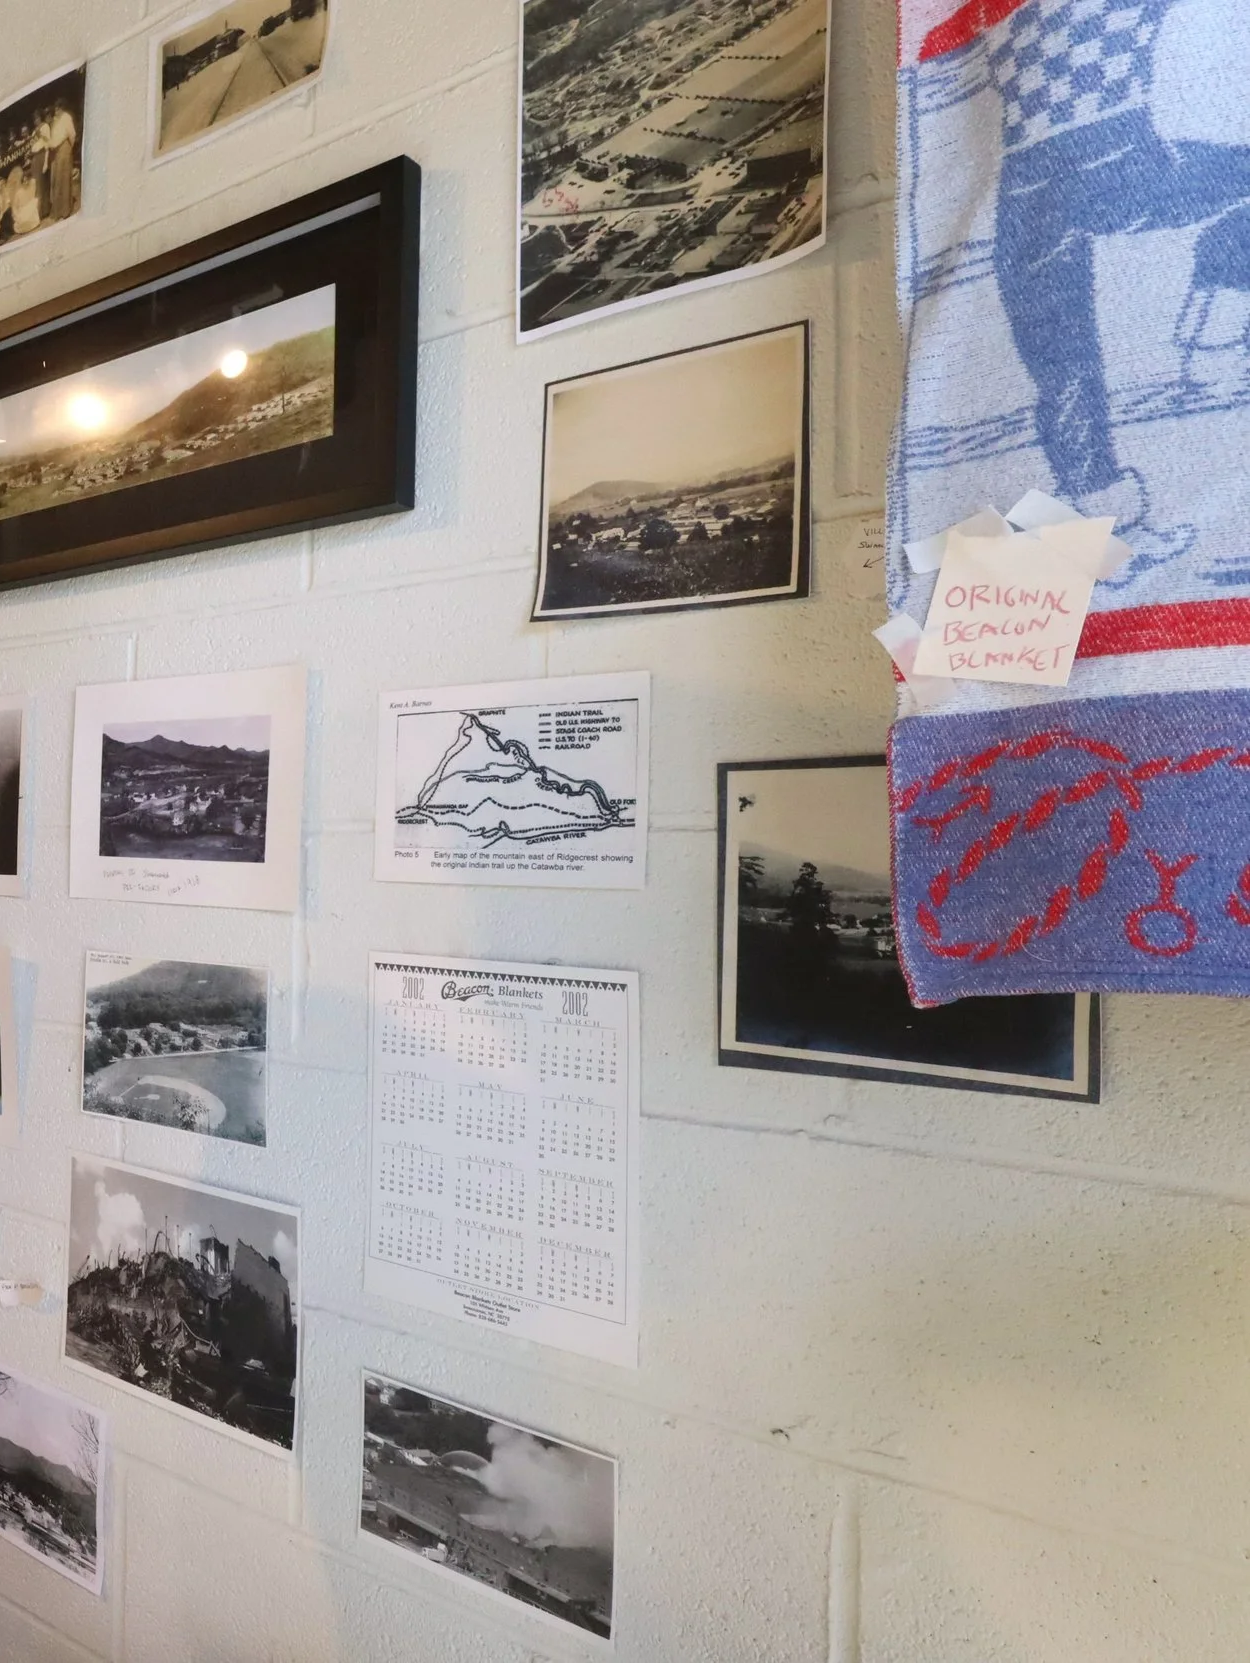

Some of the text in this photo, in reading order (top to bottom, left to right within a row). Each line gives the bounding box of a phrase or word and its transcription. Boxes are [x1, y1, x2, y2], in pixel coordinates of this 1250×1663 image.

[945, 584, 1070, 614] ORIGINAL
[943, 614, 1051, 646] BEACON
[950, 644, 1070, 671] BLANKET
[526, 832, 586, 845] CATAWBA RIVER
[434, 852, 450, 860] Early
[557, 853, 598, 862] Ridgecrest
[600, 854, 633, 863] showing
[403, 976, 588, 1016] 2002 Beacon Blankets 2002
[522, 1002, 543, 1010] Friends
[538, 1167, 614, 1188] SEPTEMBER
[386, 1202, 435, 1217] OCTOBER
[456, 1218, 524, 1239] NOVEMBER
[540, 1237, 613, 1259] DECEMBER
